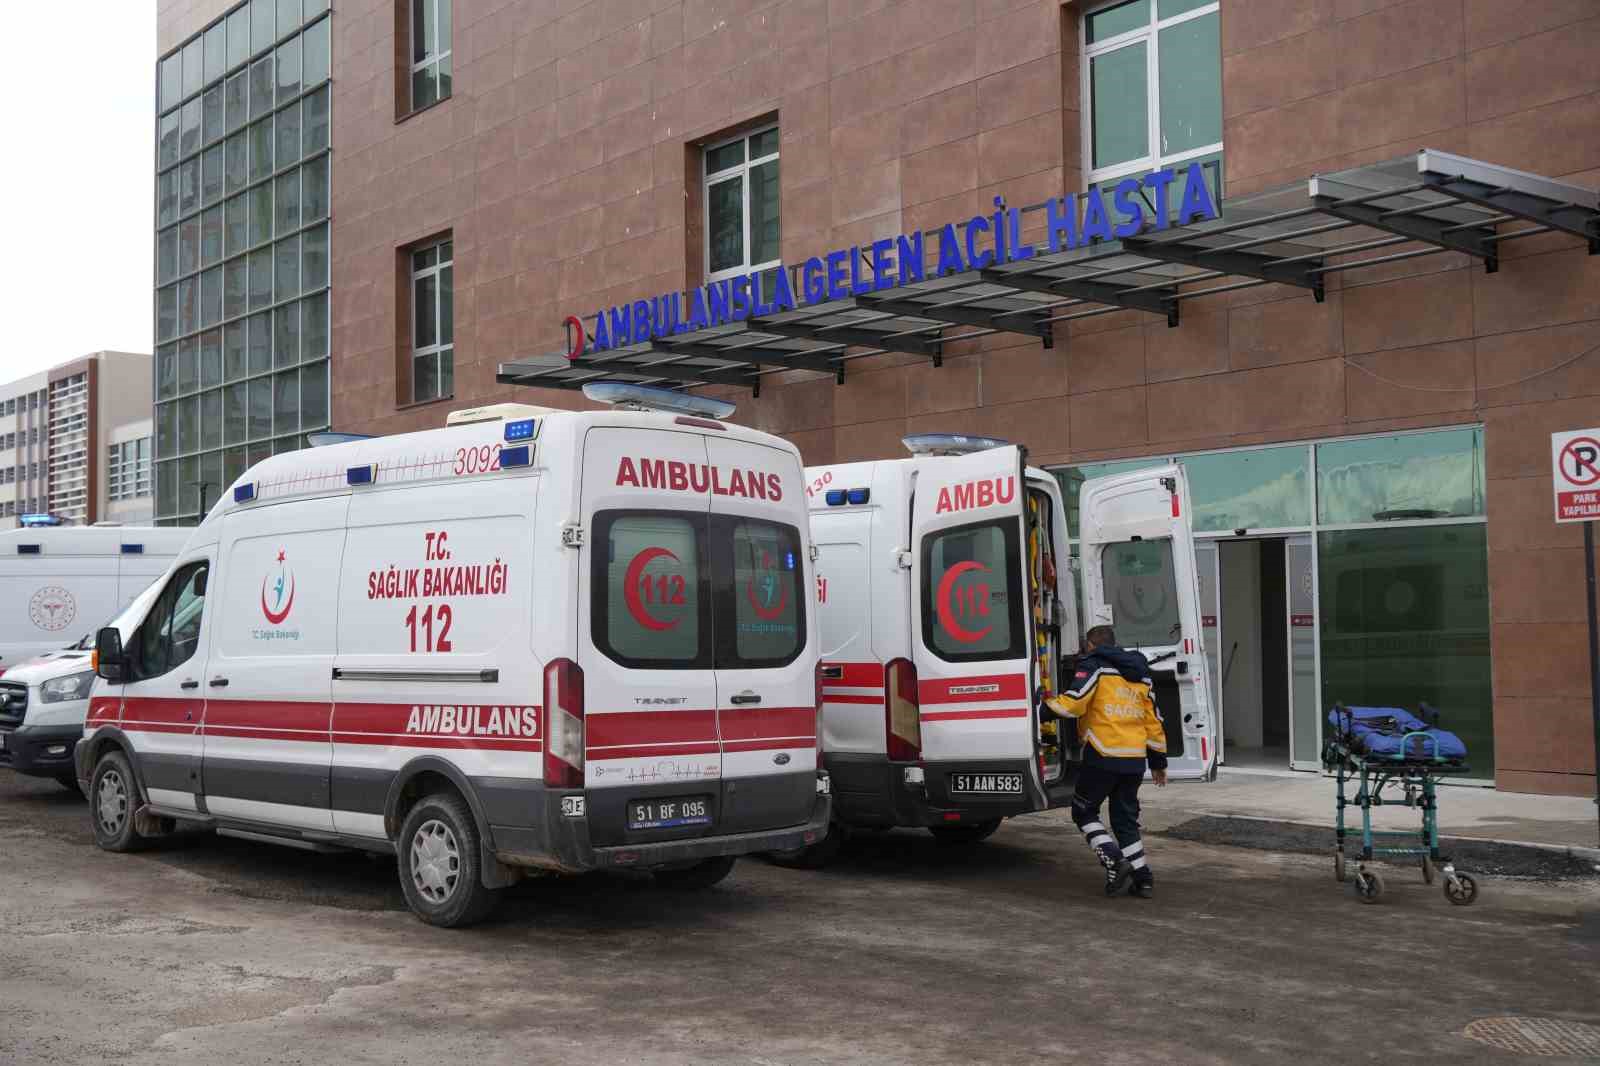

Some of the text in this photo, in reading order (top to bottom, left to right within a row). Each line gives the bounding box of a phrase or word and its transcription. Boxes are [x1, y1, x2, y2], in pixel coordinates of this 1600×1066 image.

[593, 162, 1217, 351] AMBULANSLA GELEN ACİL HASTA
[455, 443, 503, 475] 3092
[615, 456, 783, 502] AMBULANS
[935, 476, 1015, 514] AMBU
[1573, 493, 1597, 504] PARK
[425, 531, 451, 561] T.C.
[367, 557, 508, 600] SAĞLIK BAKANLIĞI
[641, 574, 687, 606] 112
[955, 582, 990, 618] 112
[405, 604, 452, 652] 112
[406, 705, 537, 736] AMBULANS
[957, 774, 1020, 791] 51 AAN 583
[636, 801, 705, 821] 51 BF 095
